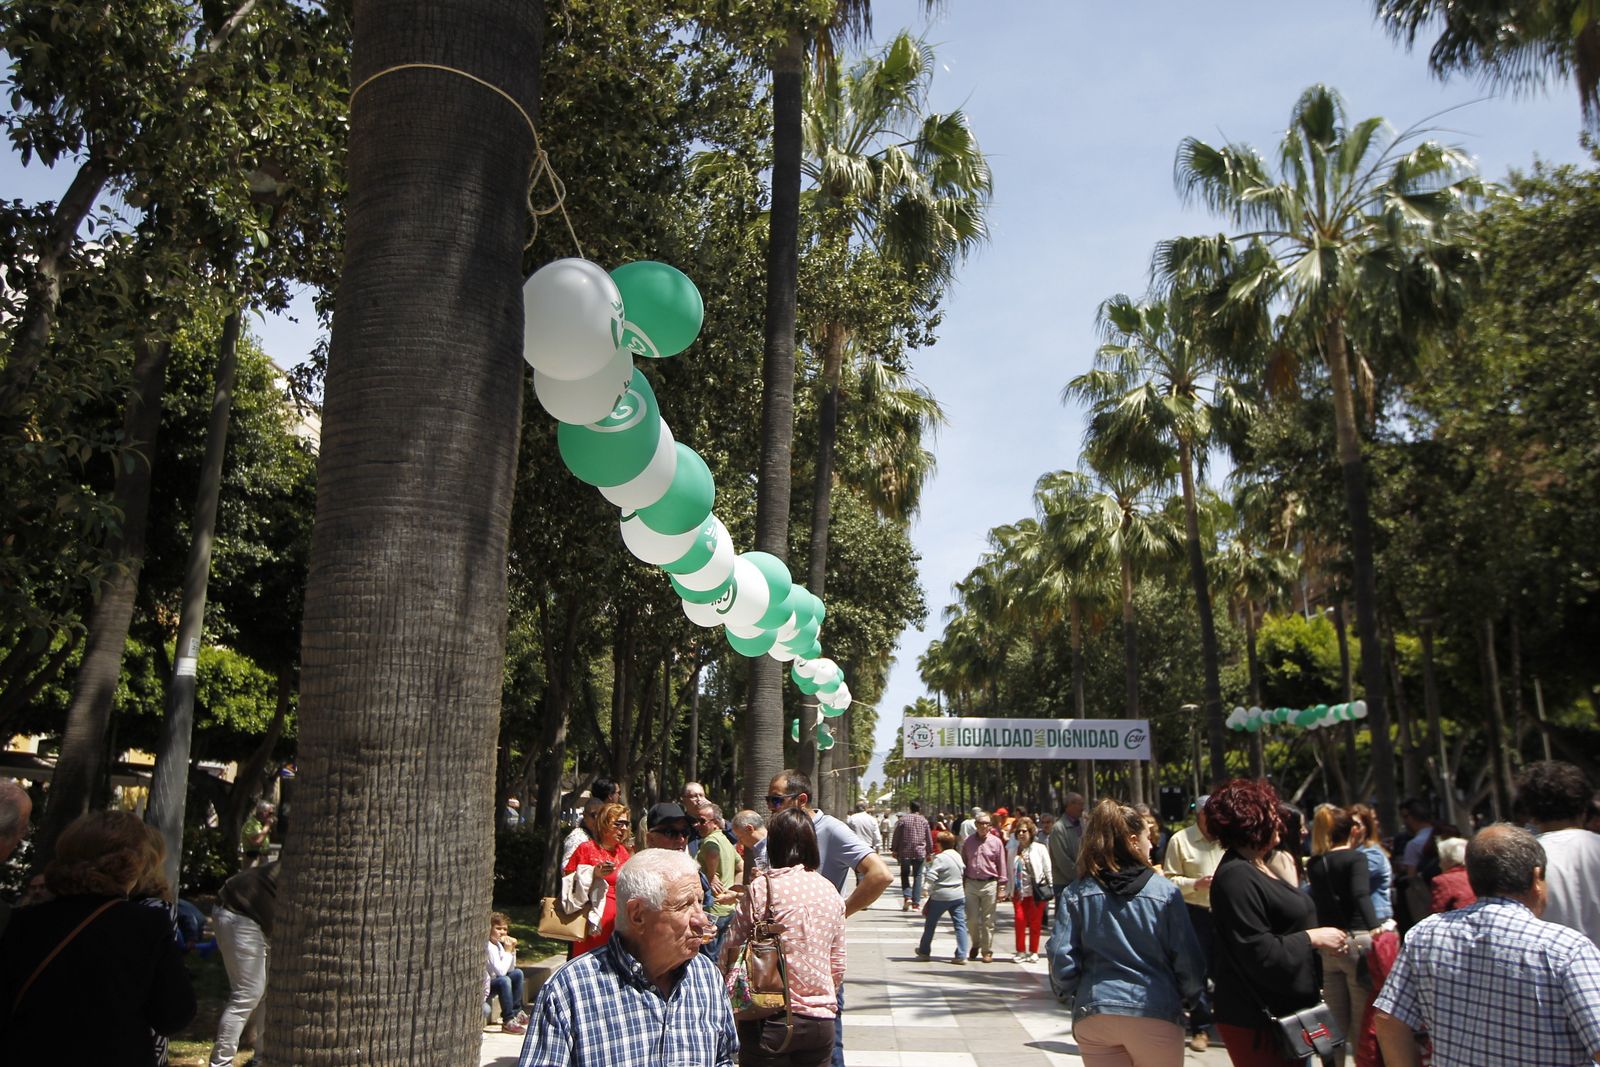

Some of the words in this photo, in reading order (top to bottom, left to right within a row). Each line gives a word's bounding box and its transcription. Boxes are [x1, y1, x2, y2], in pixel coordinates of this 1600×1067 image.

[936, 727, 946, 747] 1
[957, 727, 1033, 747] IGUALDAD
[1047, 728, 1119, 749] DIGNIDAD
